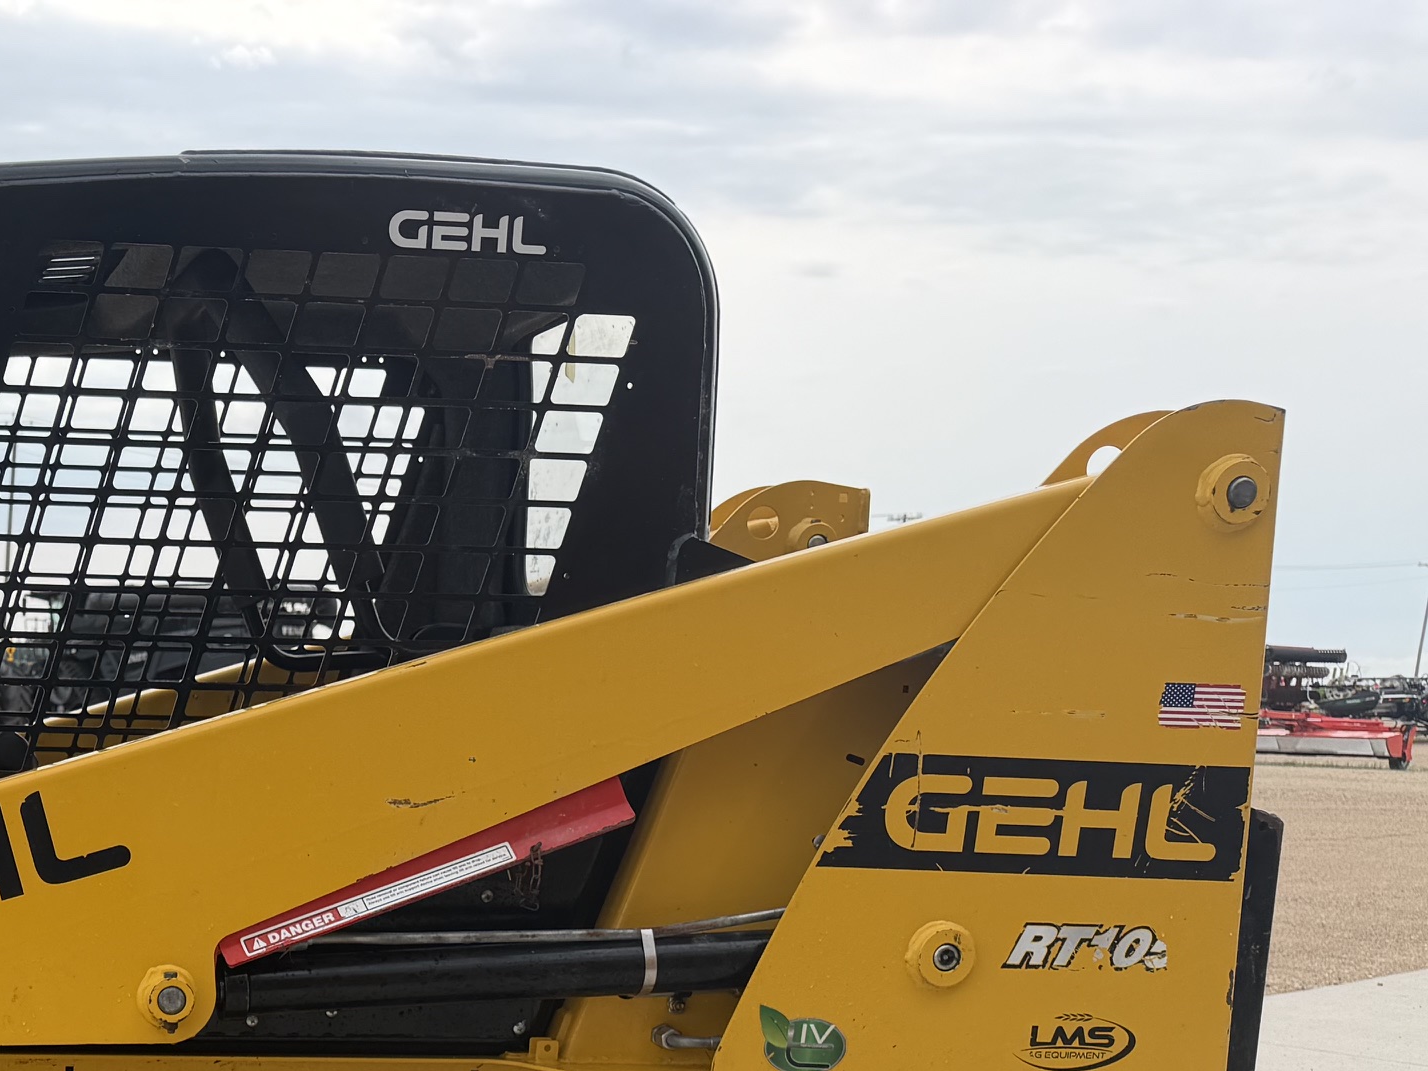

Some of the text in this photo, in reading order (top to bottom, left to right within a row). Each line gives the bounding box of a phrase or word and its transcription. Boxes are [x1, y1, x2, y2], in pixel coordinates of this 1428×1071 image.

[388, 209, 547, 255] GEHL
[883, 773, 1218, 863] GEHL
[267, 912, 336, 944] DANGER
[1029, 1025, 1117, 1048] LMS
[1044, 1051, 1107, 1060] EQUIPMENT
